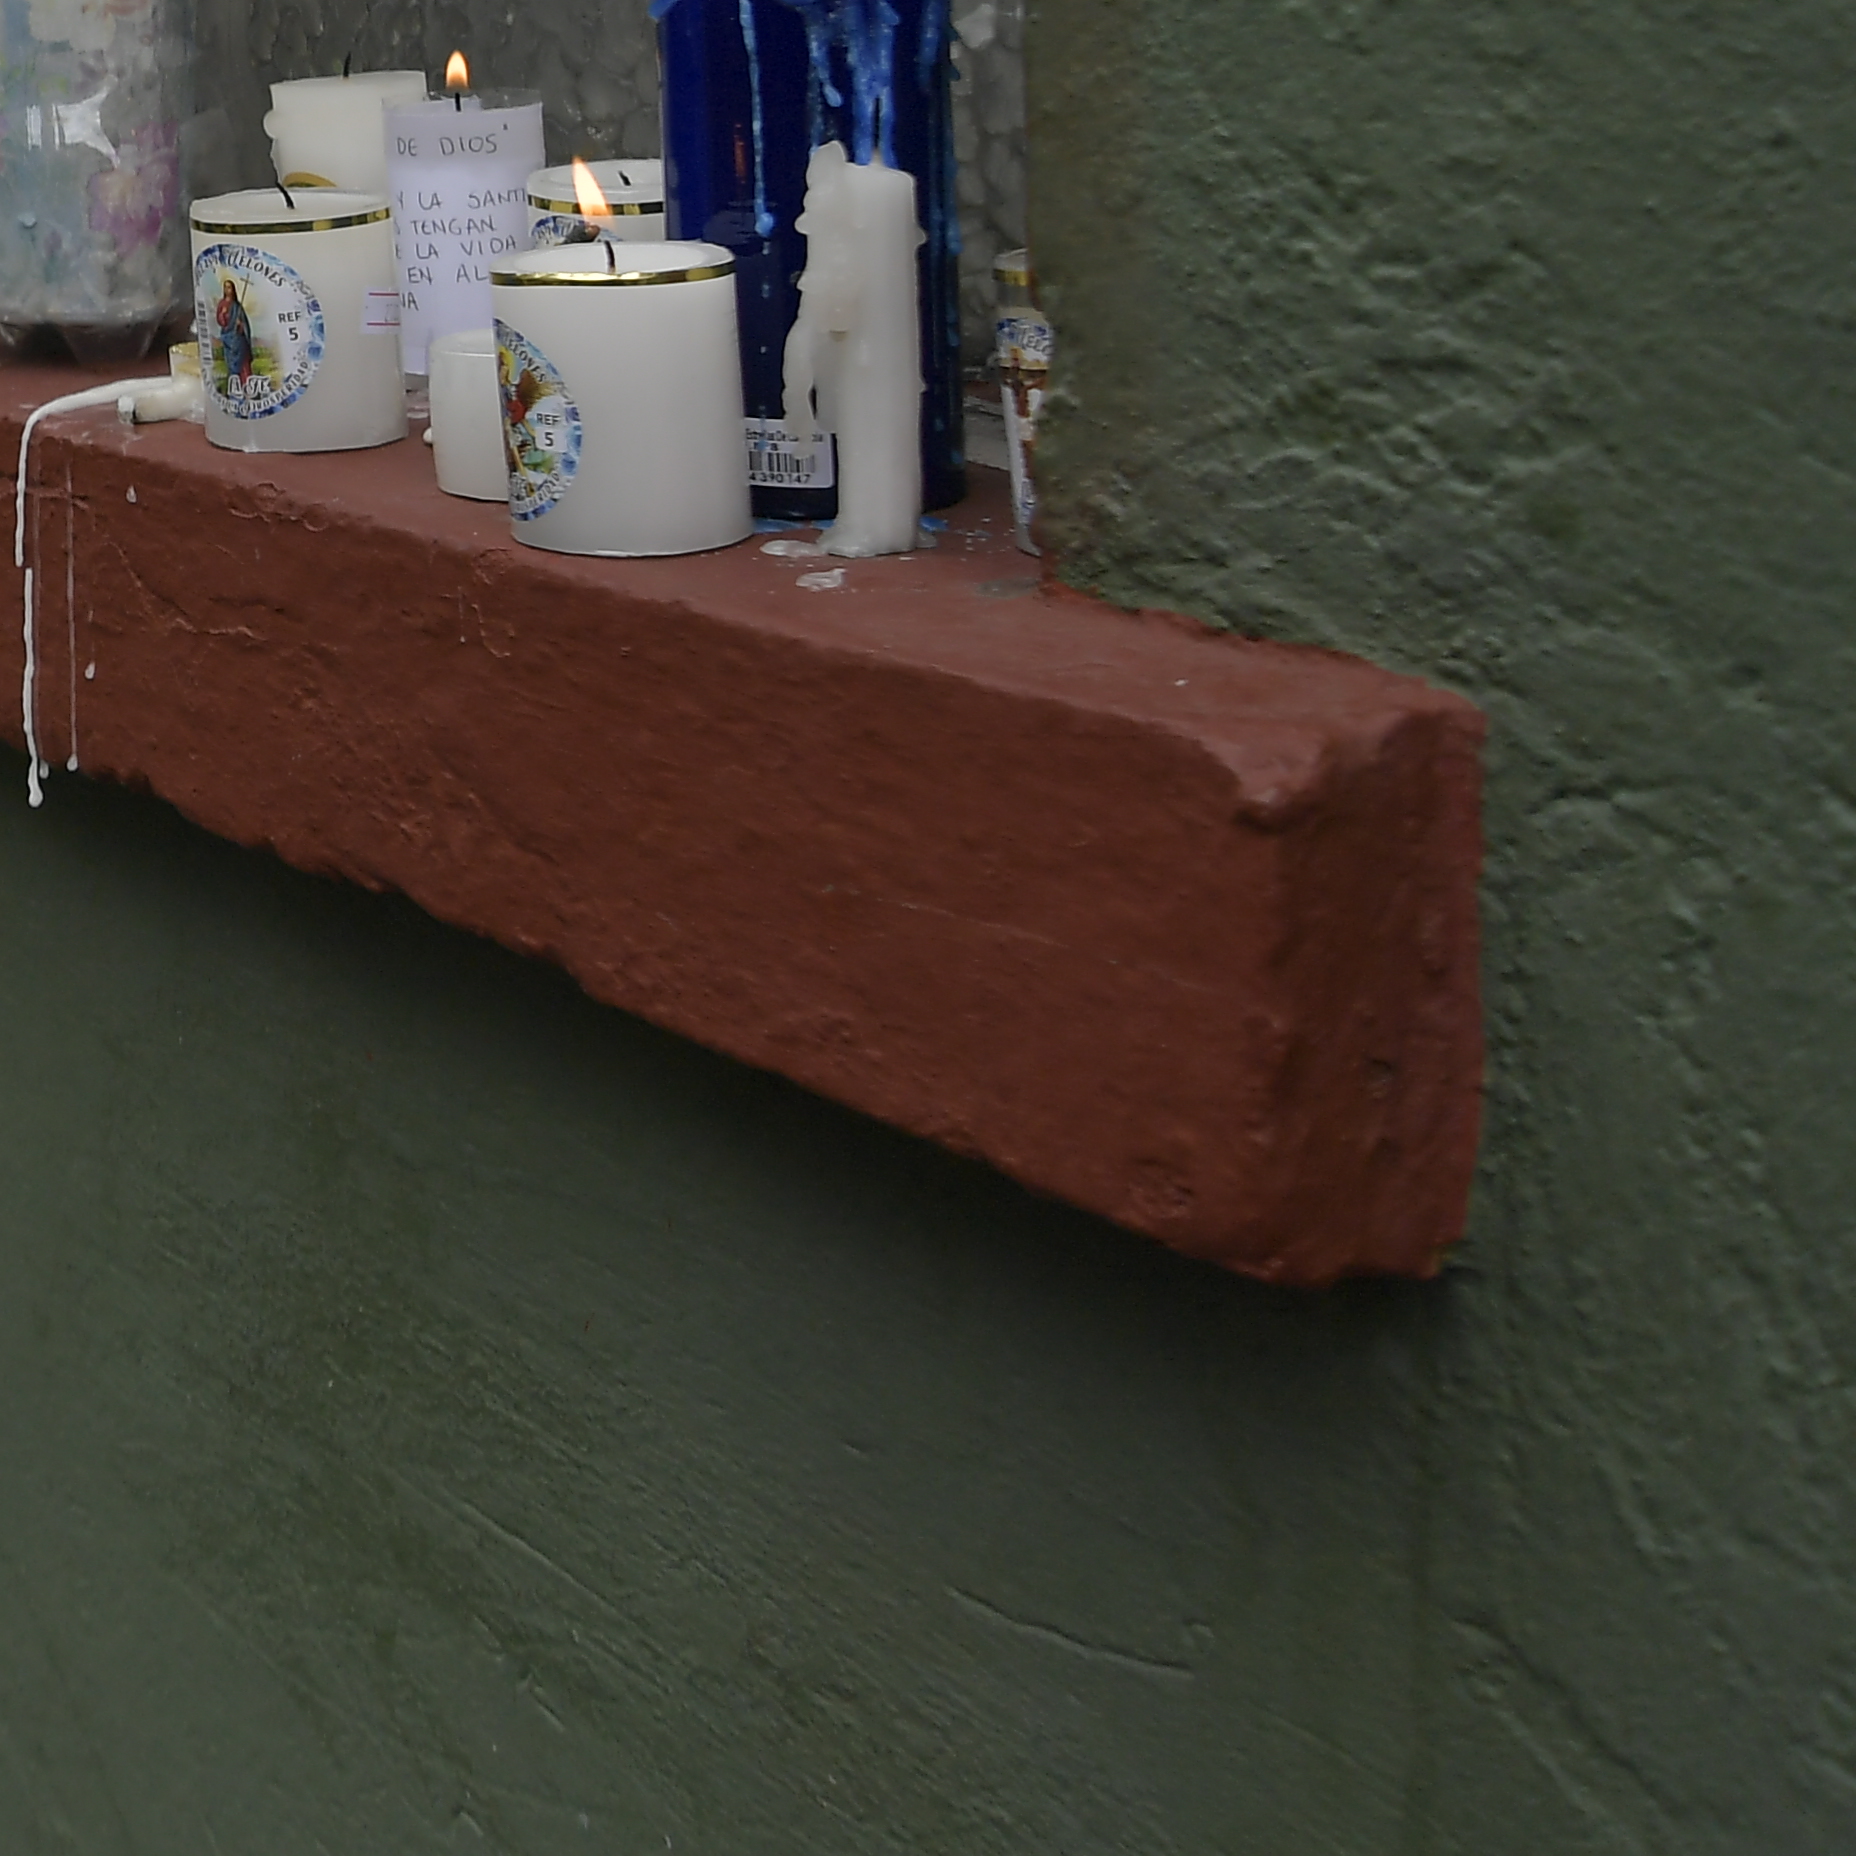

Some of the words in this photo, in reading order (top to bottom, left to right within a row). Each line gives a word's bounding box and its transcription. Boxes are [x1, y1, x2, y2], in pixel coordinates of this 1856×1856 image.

[397, 136, 417, 157] DE
[440, 133, 498, 157] DIOS
[418, 190, 443, 211] LA
[410, 214, 497, 236] TENGAN
[415, 242, 439, 260] LA
[460, 234, 518, 258] VIDA
[407, 266, 433, 286] EN
[278, 310, 302, 324] REF
[288, 326, 299, 341] 5
[536, 413, 561, 426] REF
[544, 431, 554, 447] 5
